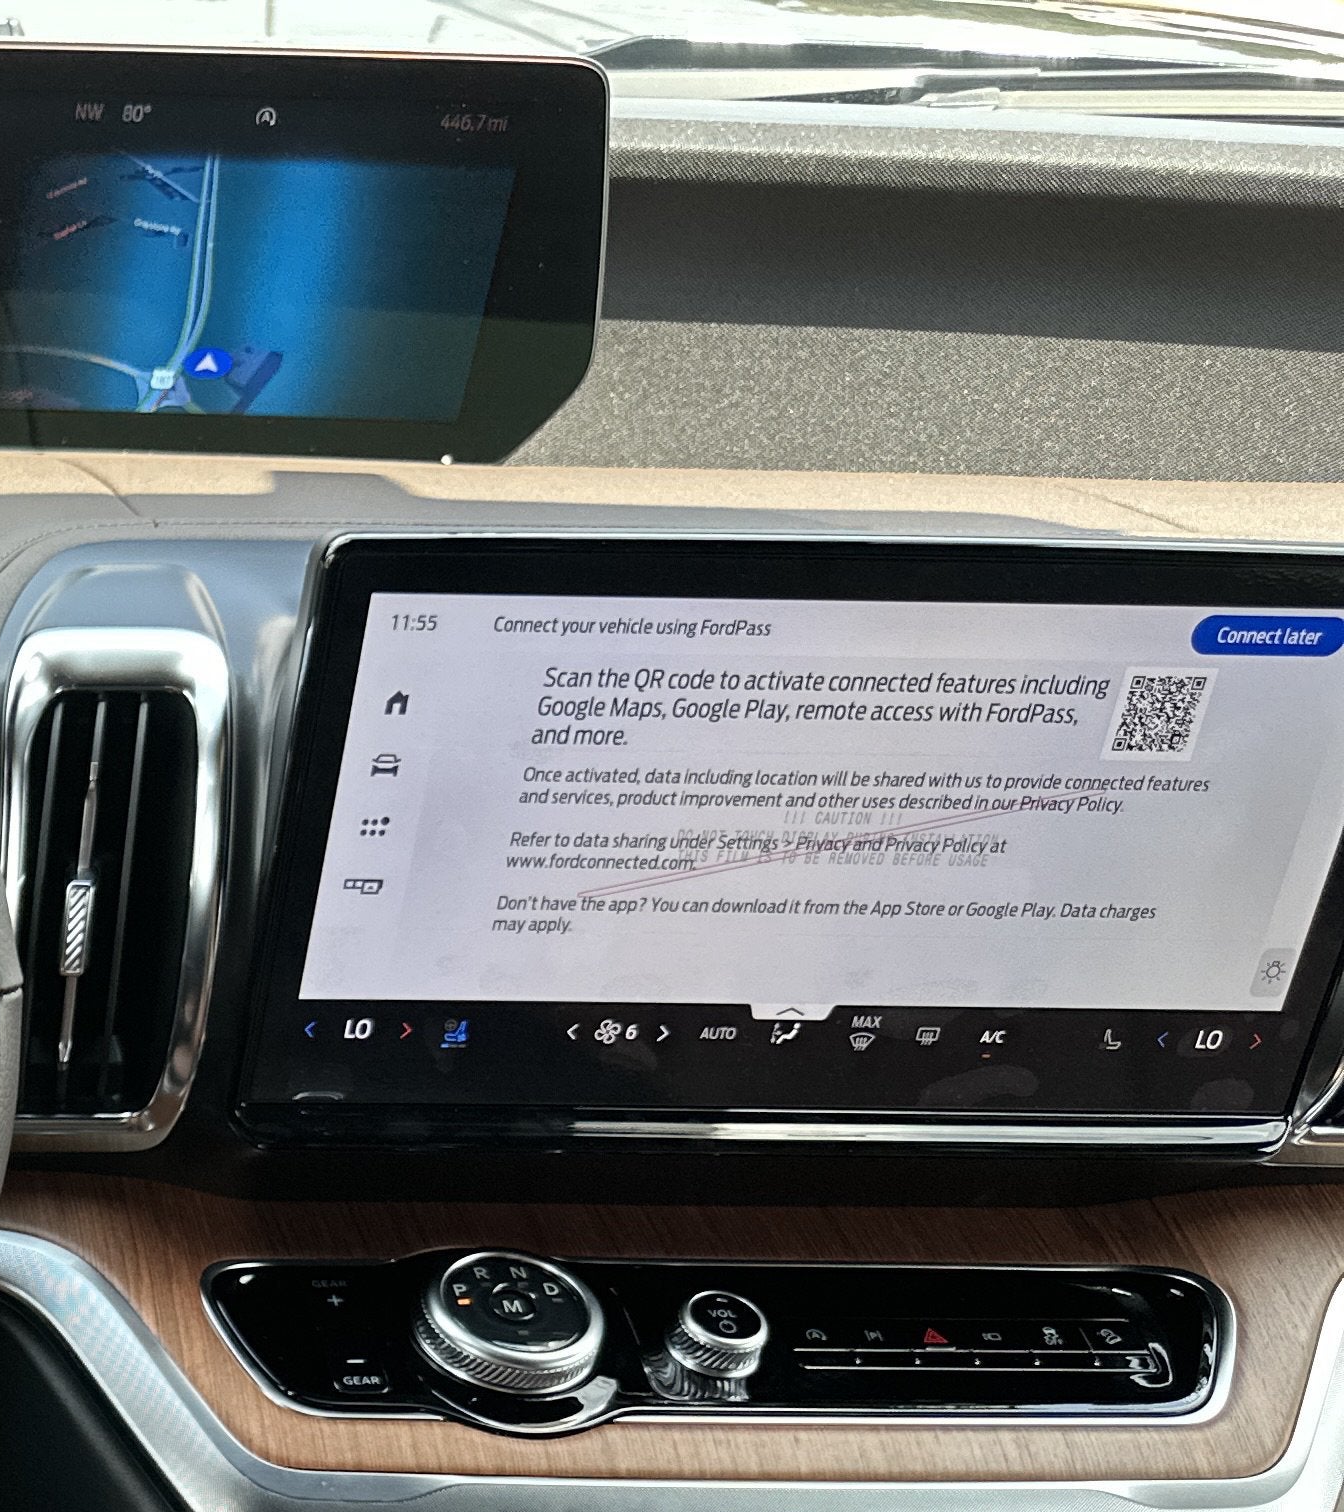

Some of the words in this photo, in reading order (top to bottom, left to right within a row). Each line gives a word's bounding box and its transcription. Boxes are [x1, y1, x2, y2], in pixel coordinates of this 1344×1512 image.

[75, 103, 105, 121] NW
[392, 614, 438, 631] 11:55
[494, 616, 559, 633] Connect
[561, 621, 596, 636] your
[599, 617, 653, 634] vehicle
[656, 618, 698, 638] using
[700, 619, 772, 636] FordPass
[1215, 626, 1283, 644] Connect
[1281, 627, 1323, 644] later
[543, 667, 593, 688] Scan
[598, 668, 630, 689] the
[634, 668, 665, 692] QR
[668, 669, 715, 690] code
[720, 670, 741, 690] to
[744, 670, 826, 691] activate
[828, 672, 934, 693] connected
[936, 672, 1017, 695] features
[1019, 674, 1111, 700] including
[538, 696, 607, 721] Google
[609, 697, 667, 721] Maps,
[672, 697, 741, 723] Google
[744, 698, 791, 723] Play,
[795, 700, 868, 721] remote
[870, 704, 935, 722] access
[939, 701, 984, 722] with
[985, 701, 1078, 726] FordPass,
[531, 724, 572, 745] and
[573, 729, 628, 746] more.
[523, 767, 562, 782] Once
[565, 768, 640, 785] activated,
[645, 768, 681, 784] data
[683, 768, 753, 788] including
[755, 770, 818, 786] location
[822, 770, 848, 786] will
[850, 771, 871, 787] be
[872, 771, 926, 787] shared
[929, 772, 962, 788] with
[964, 776, 983, 788] us
[986, 774, 1002, 788] to
[1001, 774, 1062, 792] provide
[1065, 775, 1146, 792] connected
[1147, 775, 1211, 792] features
[519, 788, 550, 804] and
[551, 789, 614, 807] services,
[616, 790, 677, 808] product
[679, 791, 783, 809] improvement
[785, 792, 817, 808] and
[818, 792, 860, 808] other
[862, 797, 896, 809] uses
[898, 793, 974, 810] described
[974, 795, 989, 811] in
[989, 798, 1018, 811] our
[1017, 795, 1077, 814] Privacy
[510, 832, 552, 847] Refer
[555, 833, 570, 847] to
[573, 832, 609, 848] data
[612, 833, 668, 852] sharing
[669, 834, 717, 849] under
[715, 835, 780, 852] Settings
[793, 836, 850, 853] Privacy
[852, 836, 883, 851] and
[883, 837, 940, 855] Privacy
[940, 838, 989, 855] Policy
[989, 838, 1008, 852] at
[497, 896, 538, 910] Don't
[540, 896, 580, 911] have
[581, 896, 606, 911] the
[608, 897, 648, 914] app?
[652, 897, 679, 912] You
[682, 901, 709, 912] can
[712, 898, 788, 914] download
[789, 900, 801, 914] it
[803, 899, 840, 914] from
[843, 900, 868, 915] the
[870, 900, 902, 918] App
[904, 901, 945, 916] Store
[948, 905, 965, 916] or
[966, 902, 1018, 920] Google
[1060, 903, 1096, 918] Data
[1100, 904, 1157, 921] charges
[492, 920, 526, 934] may
[343, 1020, 372, 1040] LO
[851, 1016, 882, 1029] MAX
[624, 1024, 638, 1040] 6
[699, 1026, 738, 1040] AUTO
[979, 1029, 1006, 1046] A/C
[1193, 1030, 1223, 1050] LO
[472, 1266, 488, 1280] R
[509, 1266, 526, 1280] N
[453, 1283, 468, 1298] P
[543, 1282, 560, 1296] D
[502, 1299, 523, 1316] M
[707, 1308, 738, 1319] VOL
[342, 1375, 381, 1386] GEAR
